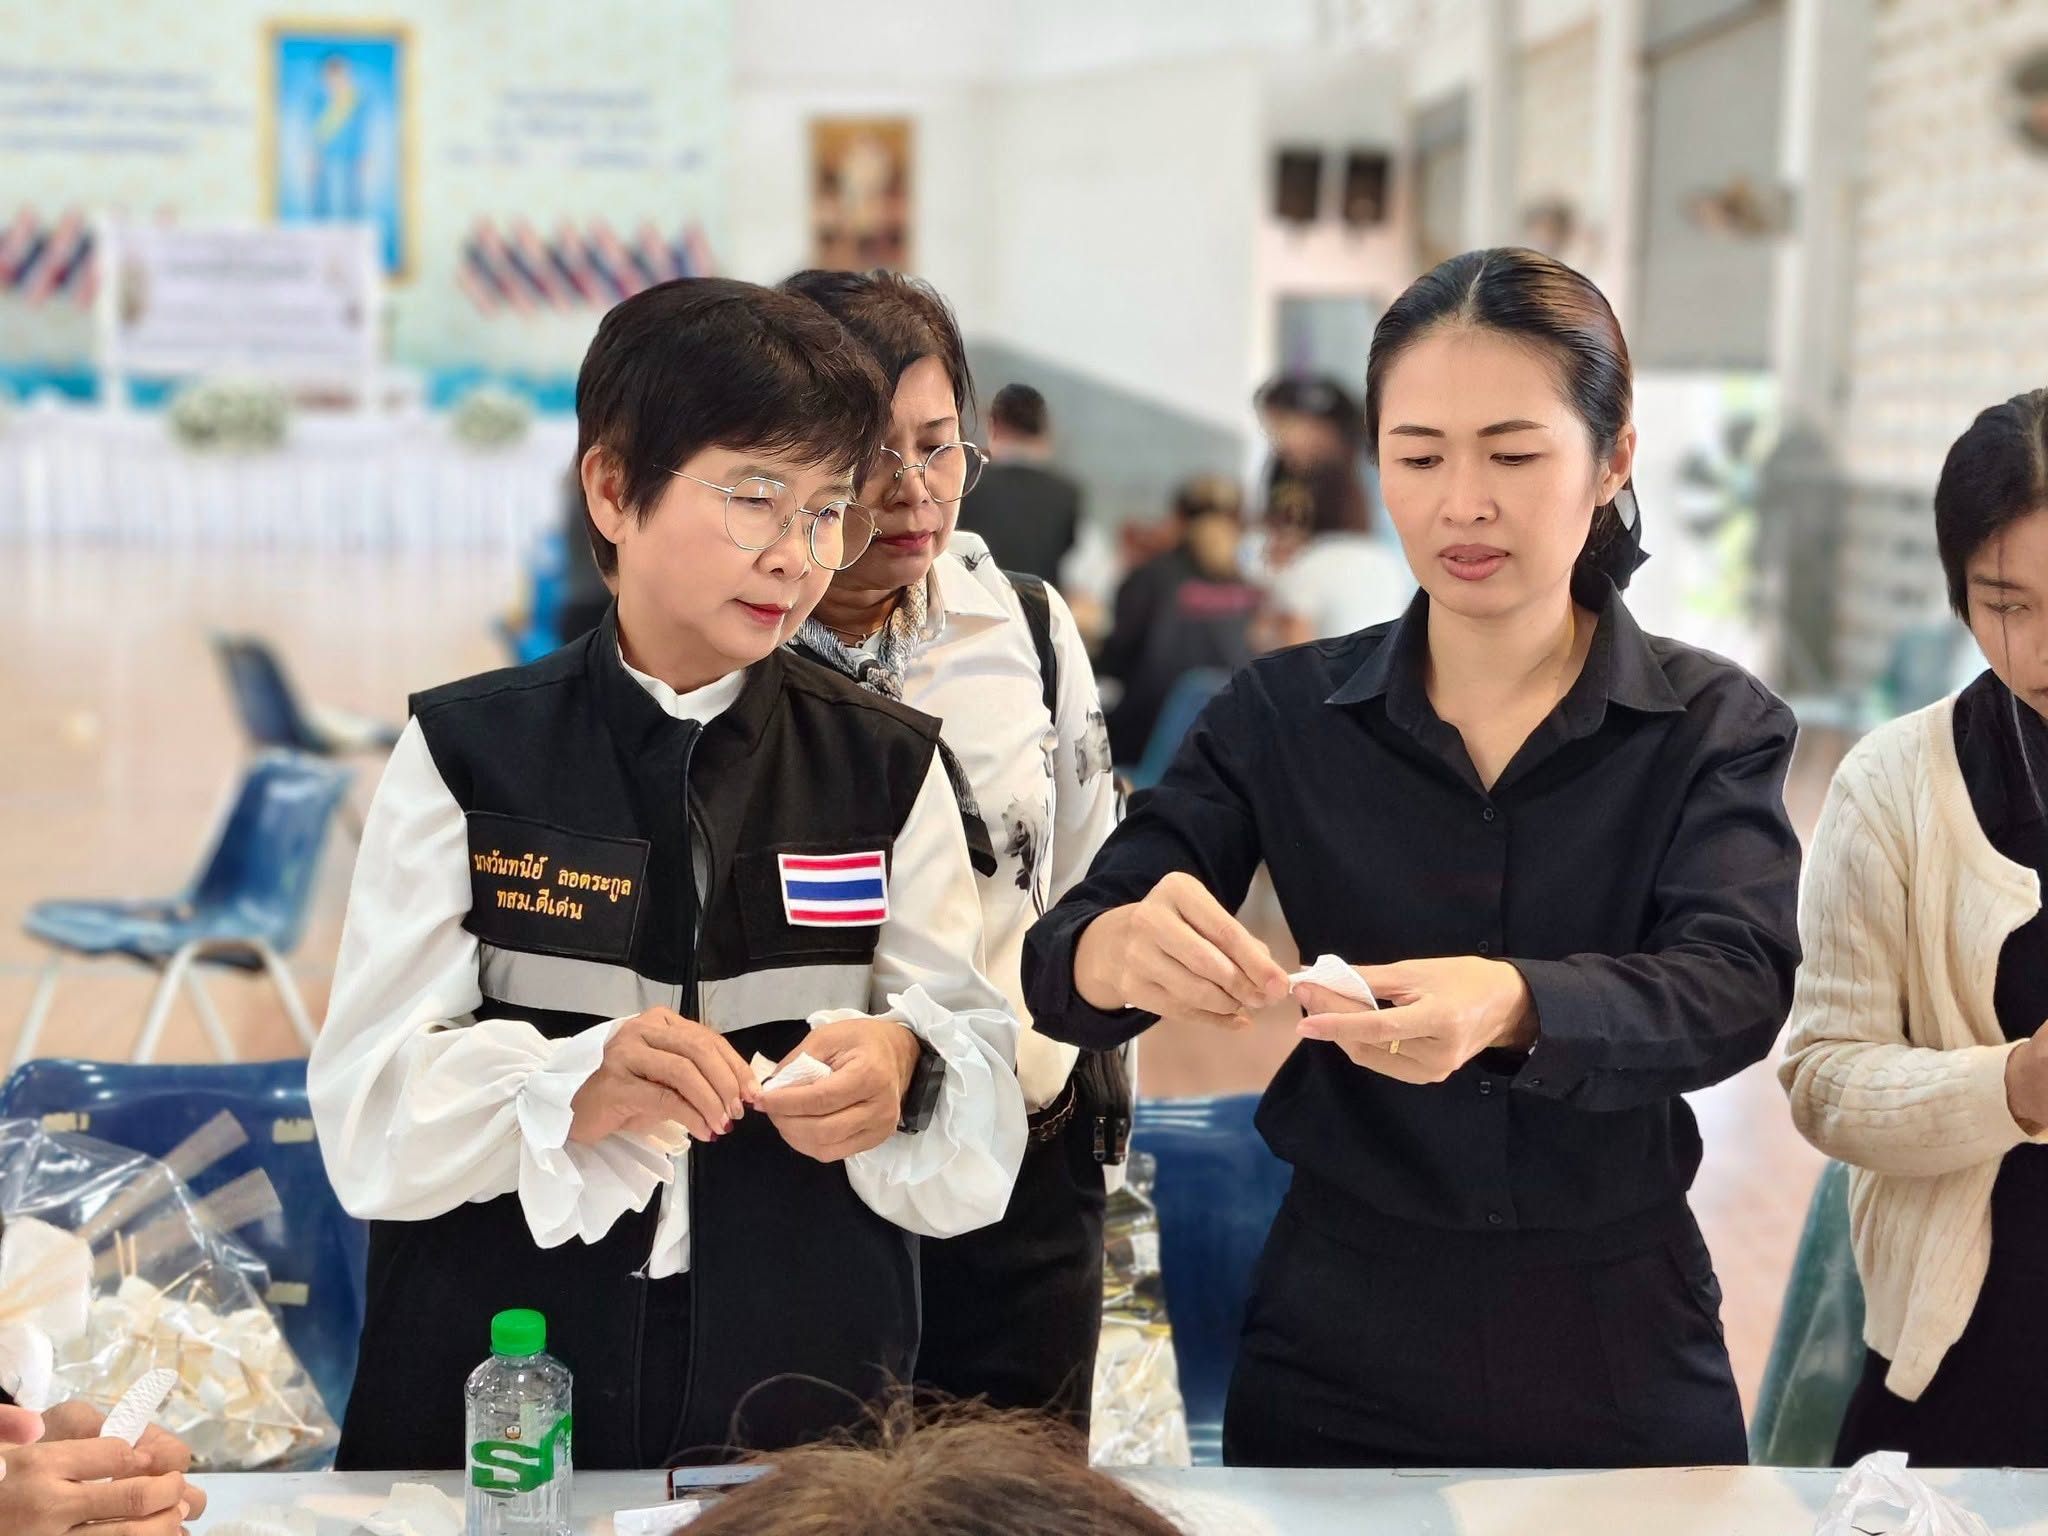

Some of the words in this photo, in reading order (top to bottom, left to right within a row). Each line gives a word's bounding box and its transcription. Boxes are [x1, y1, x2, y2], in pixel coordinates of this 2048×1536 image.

[474, 849, 549, 880] นางวันทนีย์
[496, 888, 583, 920] ทสม.ดีเด่น
